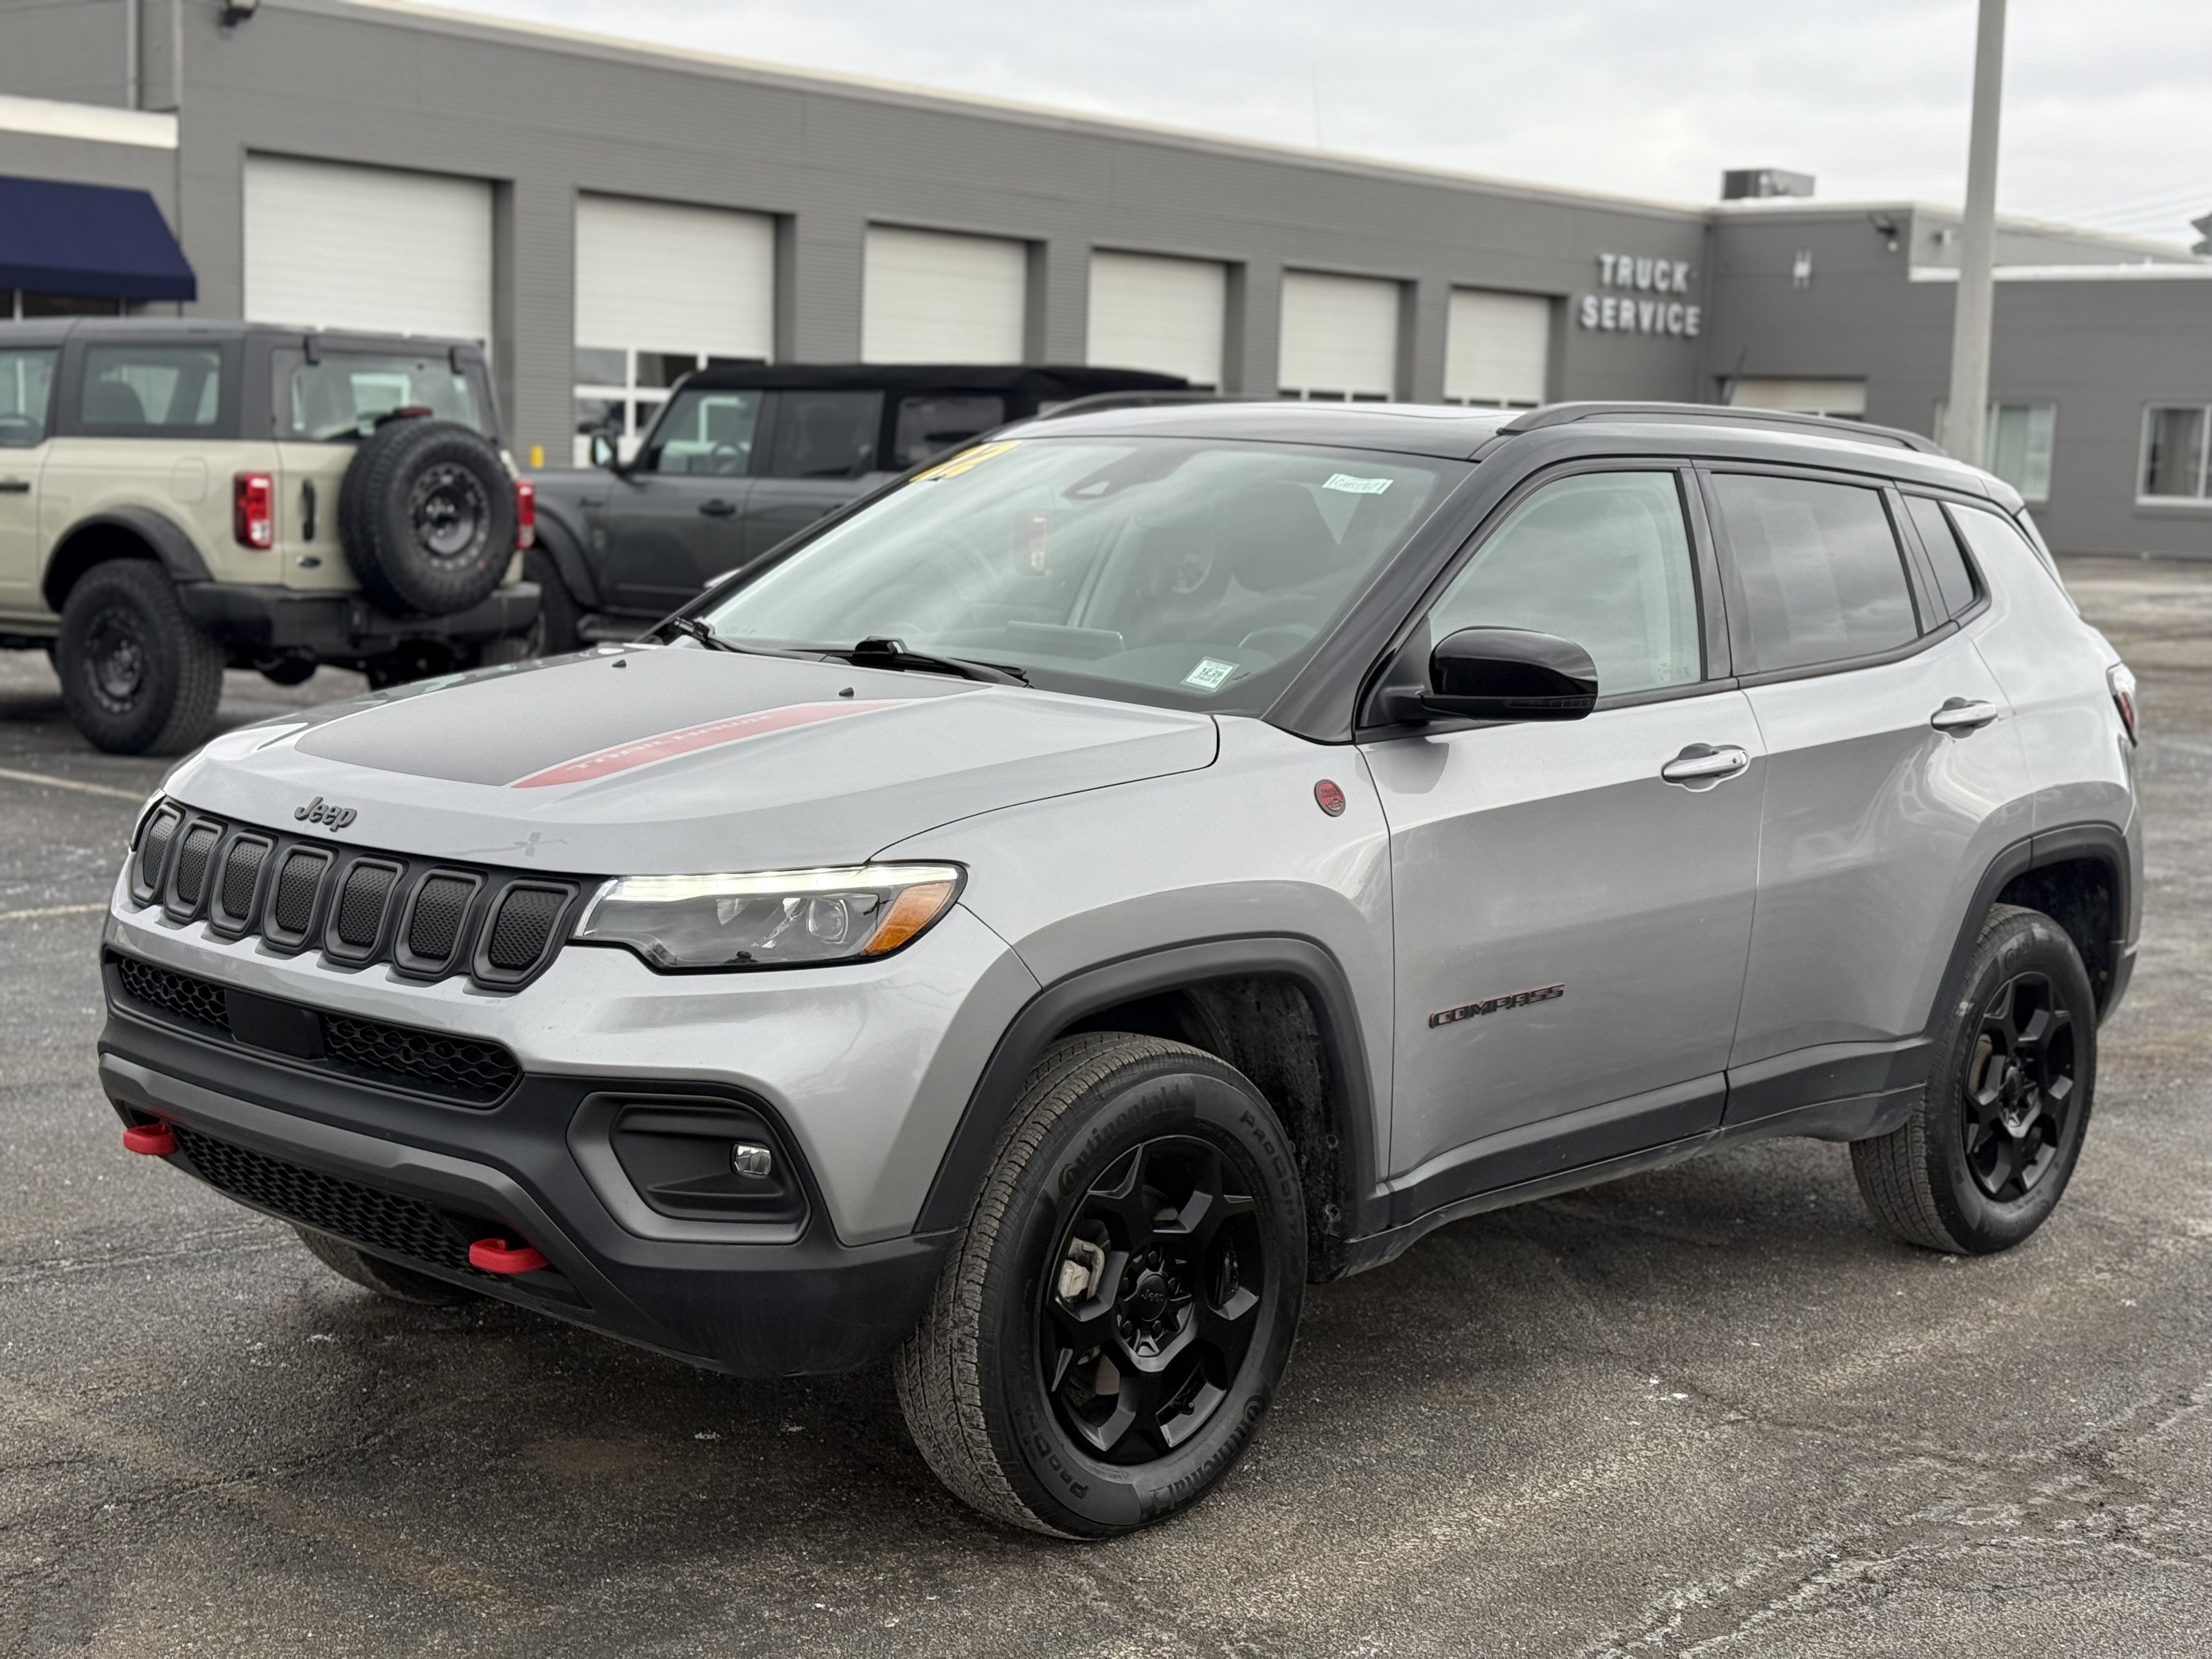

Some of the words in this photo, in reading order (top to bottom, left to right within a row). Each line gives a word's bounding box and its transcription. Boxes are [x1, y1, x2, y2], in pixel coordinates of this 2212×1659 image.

[1599, 253, 1689, 292] TRUCK
[1581, 295, 1702, 337] SERVICE
[294, 796, 357, 832] Jeep
[1428, 983, 1565, 1028] COMPASS
[1058, 1086, 1167, 1197] Continental
[1166, 1395, 1265, 1510] Continental
